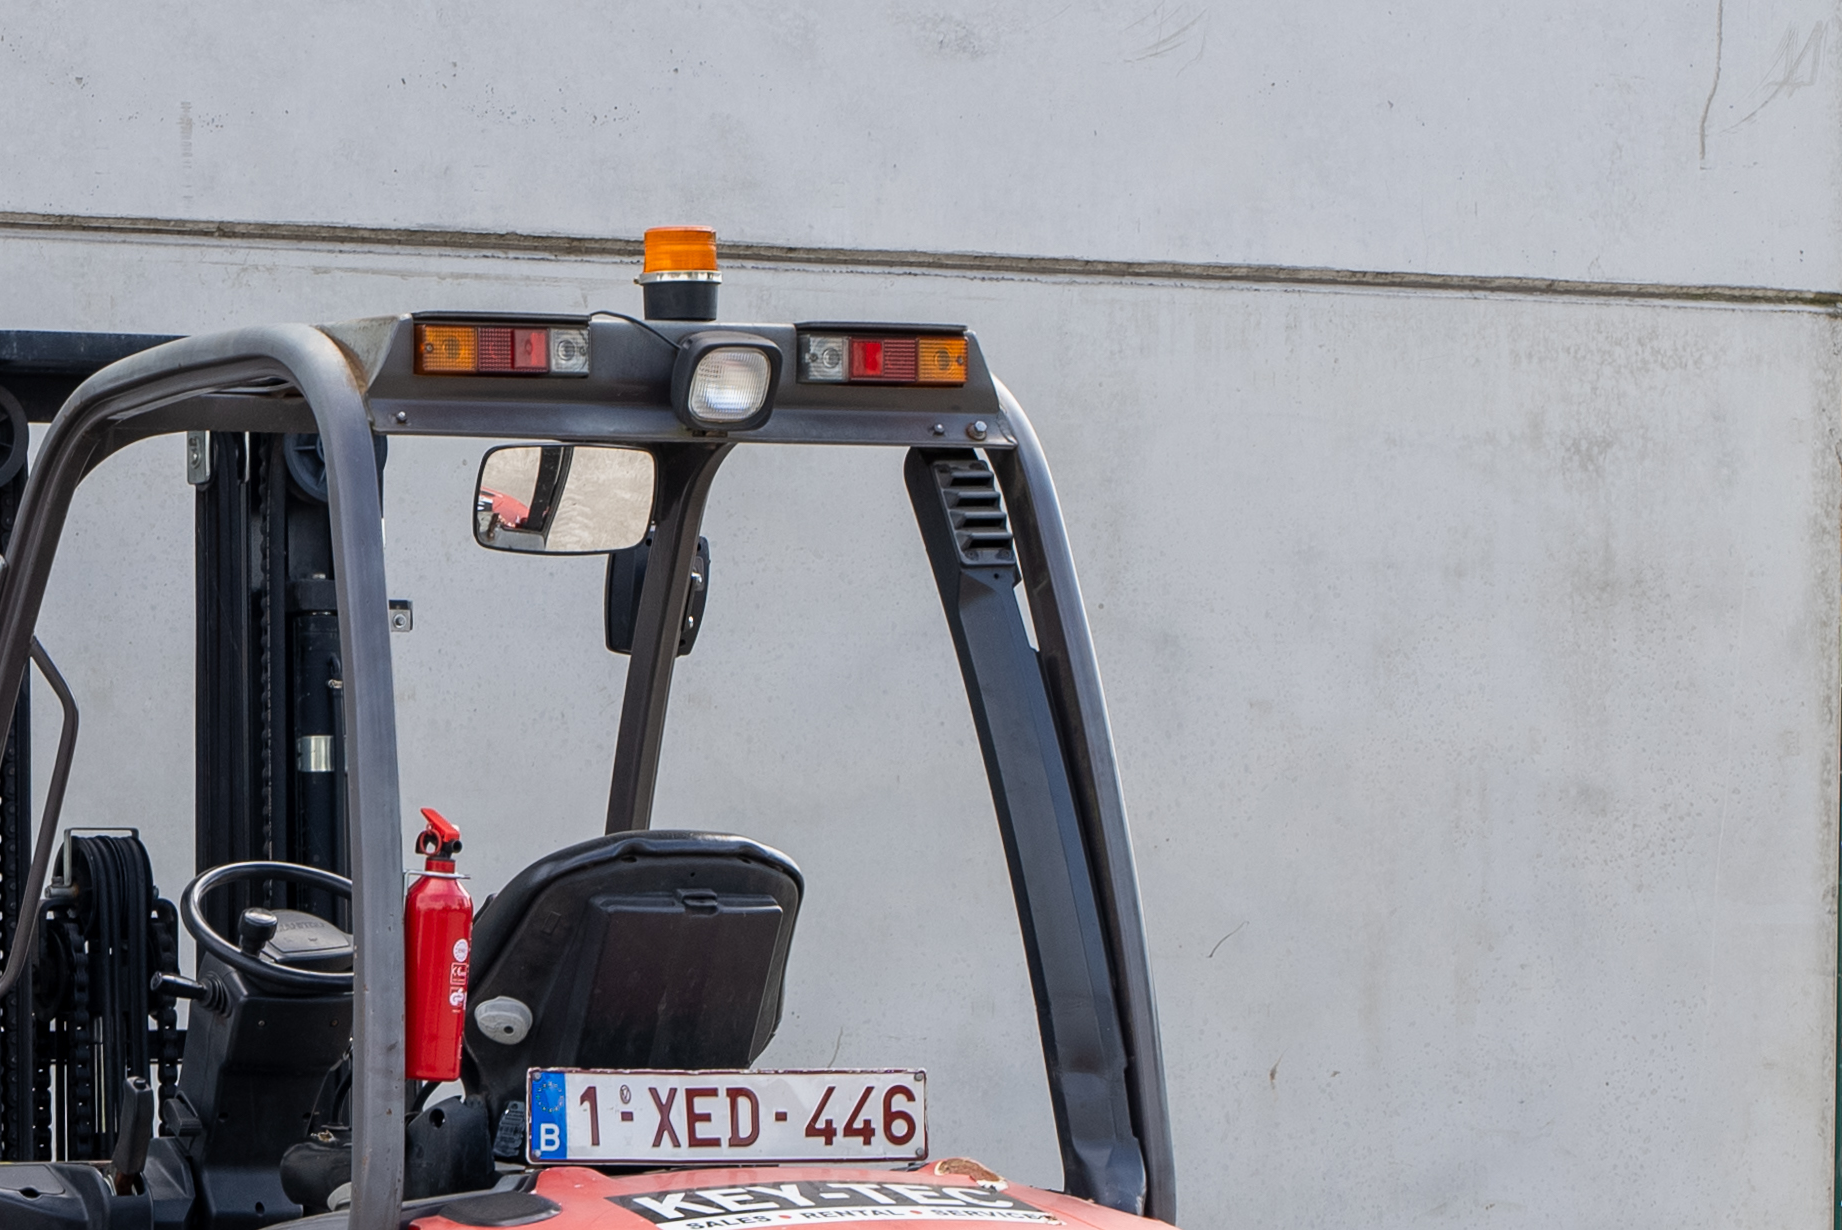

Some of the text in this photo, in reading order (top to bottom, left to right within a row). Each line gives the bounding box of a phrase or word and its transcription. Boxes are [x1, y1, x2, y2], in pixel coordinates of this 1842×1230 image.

[539, 1123, 561, 1152] B
[632, 1183, 1014, 1220] KEY-TEC
[686, 1207, 1046, 1230] SALES RENTAL SERVICE
